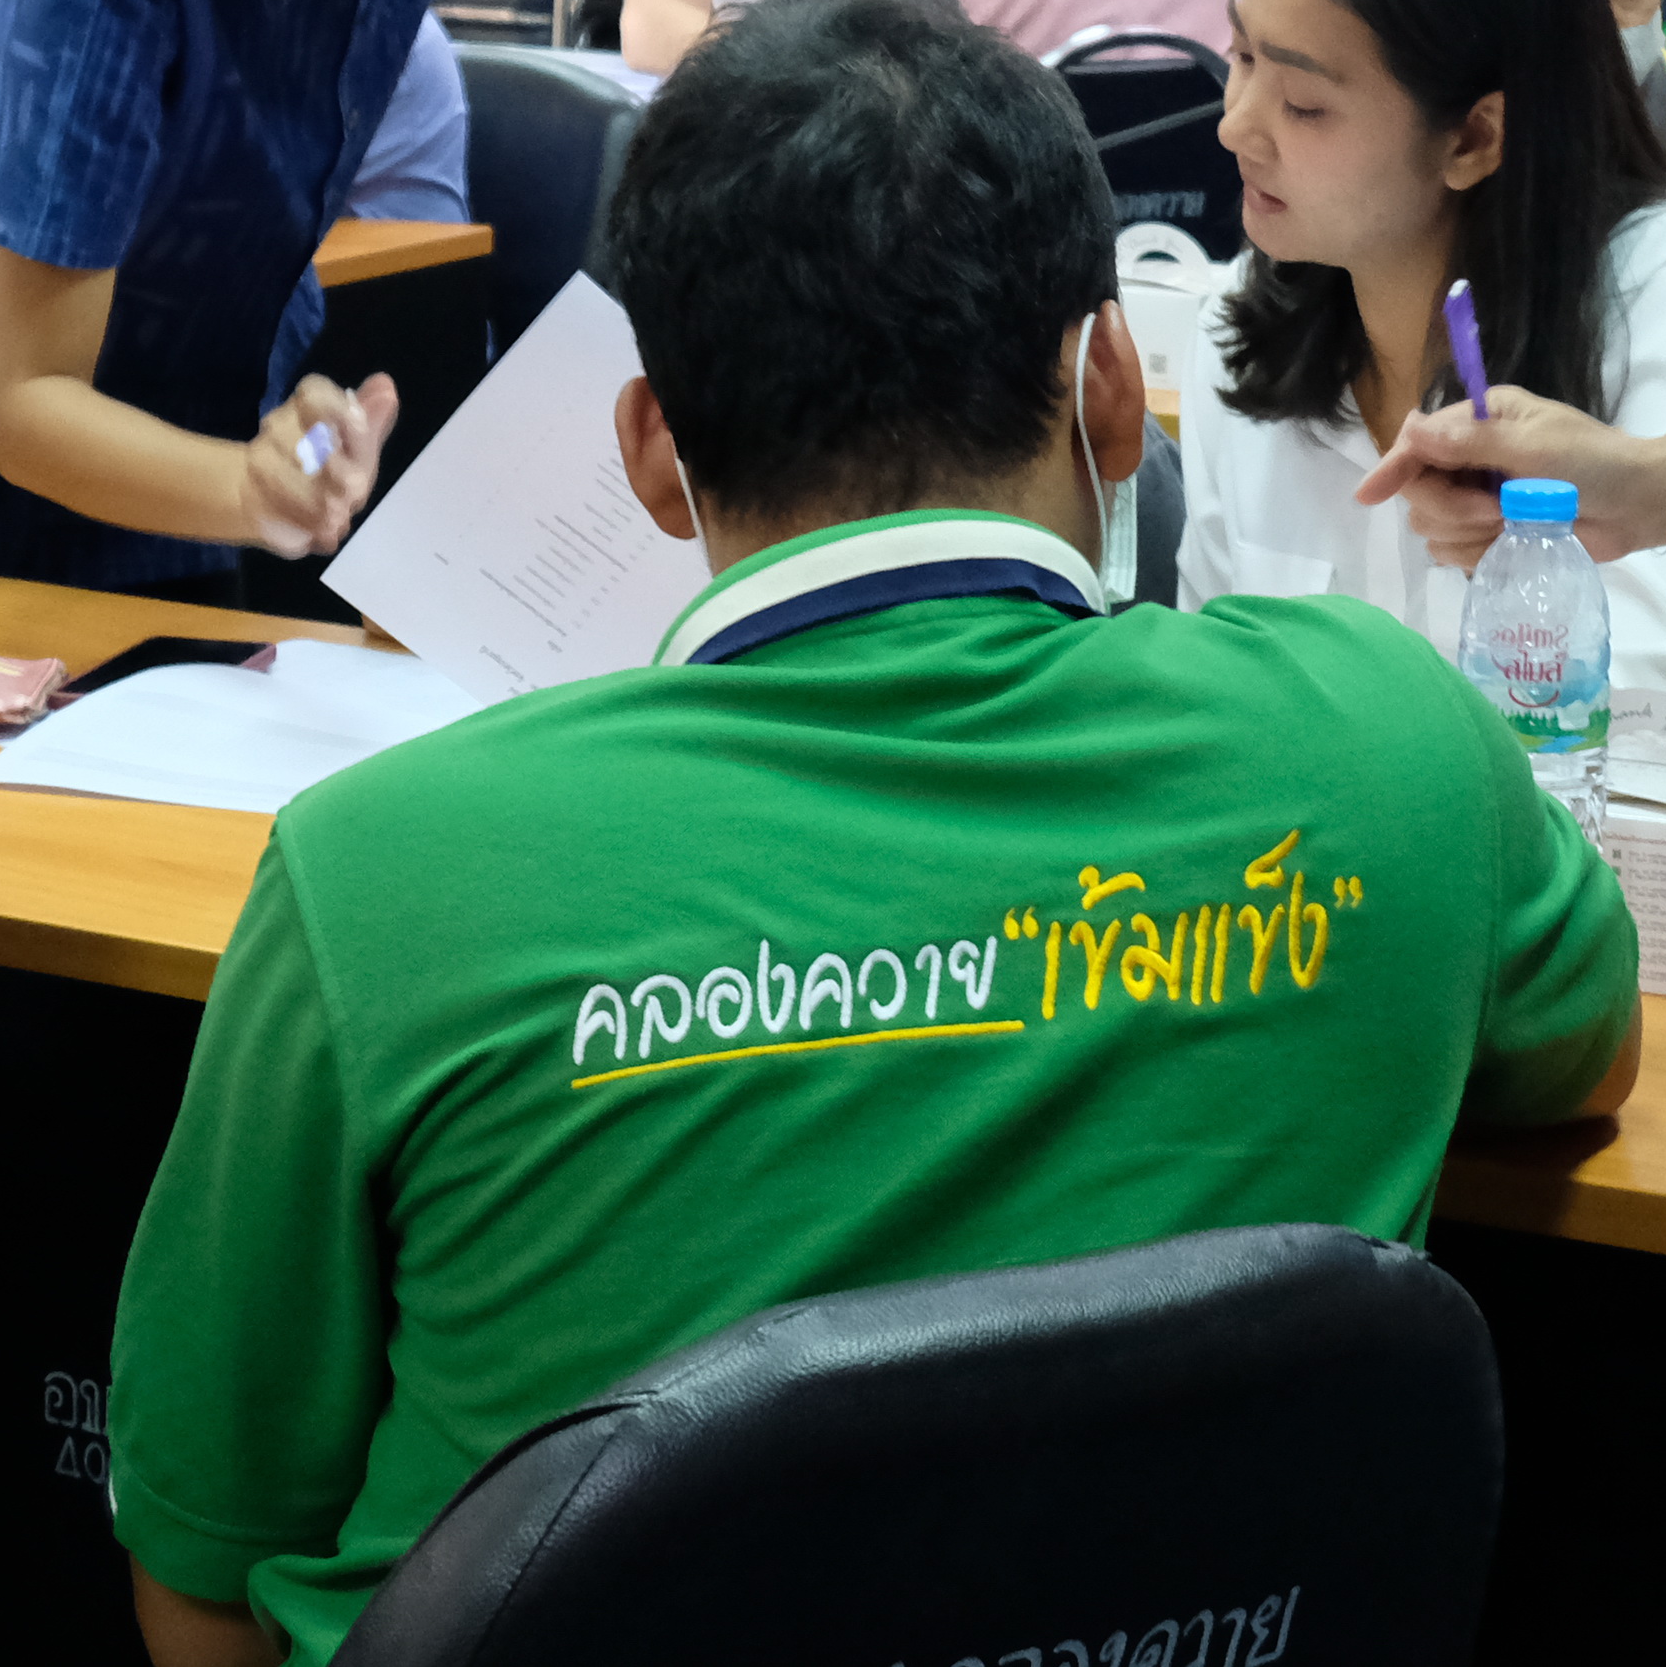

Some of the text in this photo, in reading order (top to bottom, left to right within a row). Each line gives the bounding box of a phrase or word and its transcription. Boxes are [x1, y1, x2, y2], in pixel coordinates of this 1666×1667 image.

[573, 936, 997, 1065] คลองควาย
[44, 1370, 107, 1435] อบ
